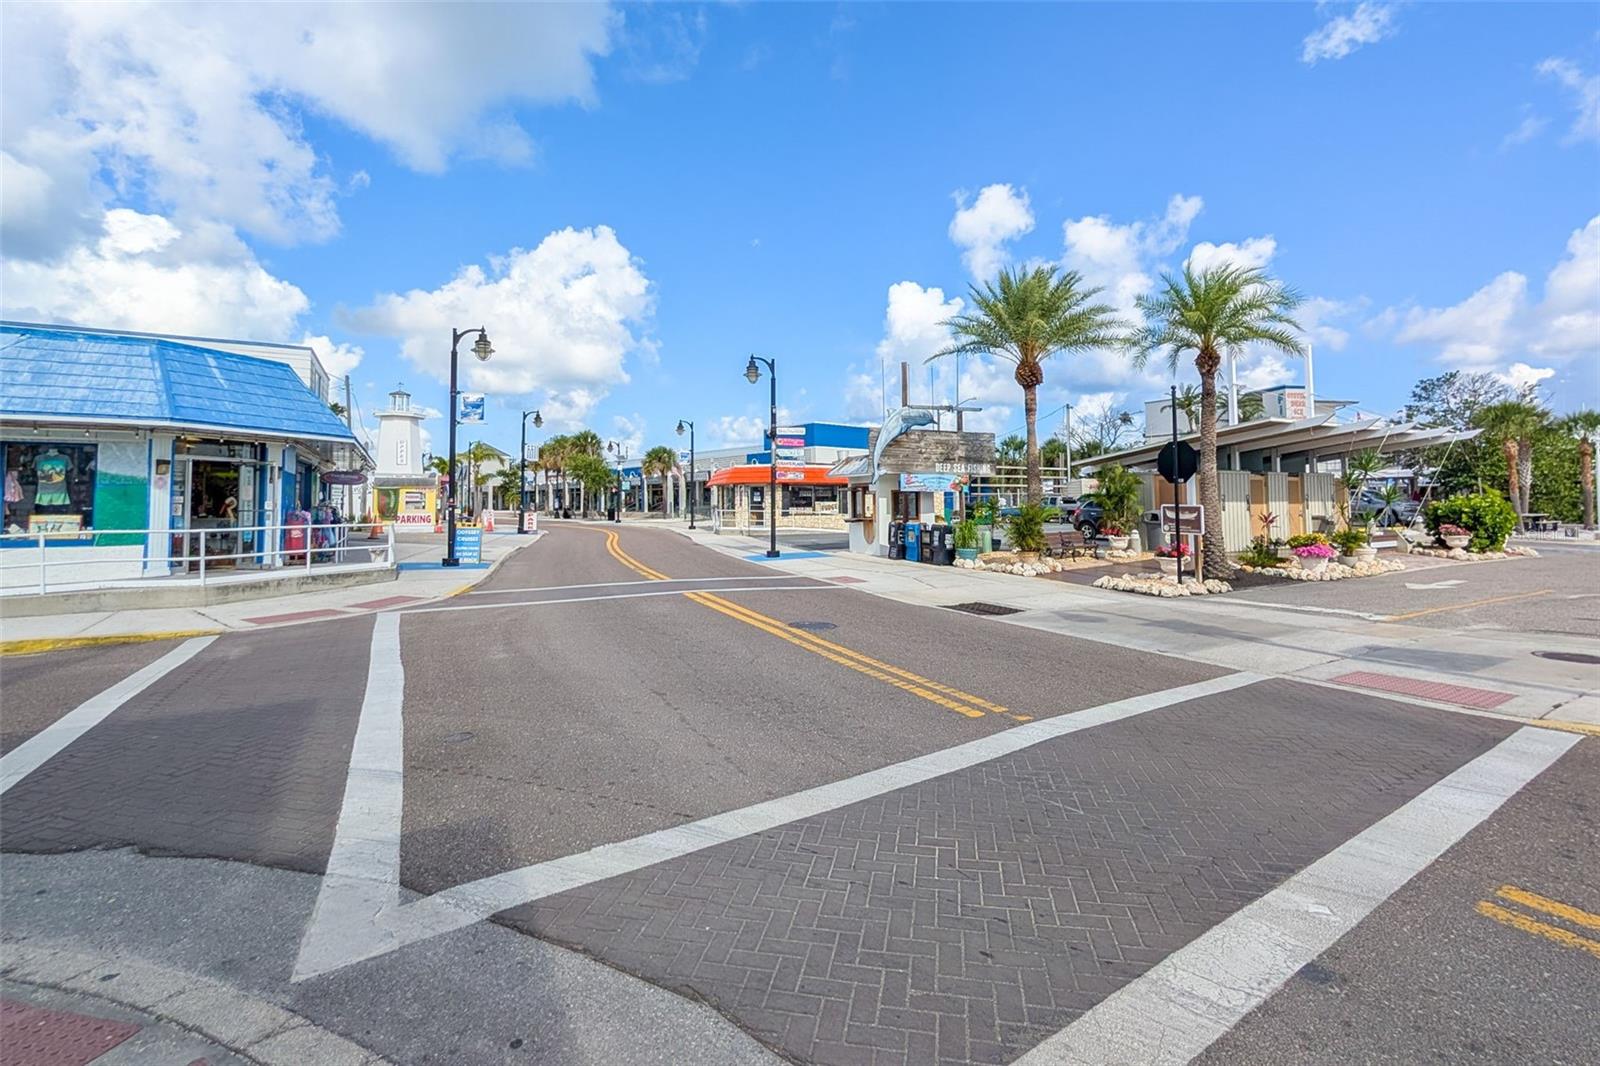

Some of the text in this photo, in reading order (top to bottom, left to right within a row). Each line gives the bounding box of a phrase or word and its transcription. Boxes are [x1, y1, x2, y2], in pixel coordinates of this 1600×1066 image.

[935, 463, 991, 473] DEEP SEA FISHING
[395, 515, 432, 524] PARKING
